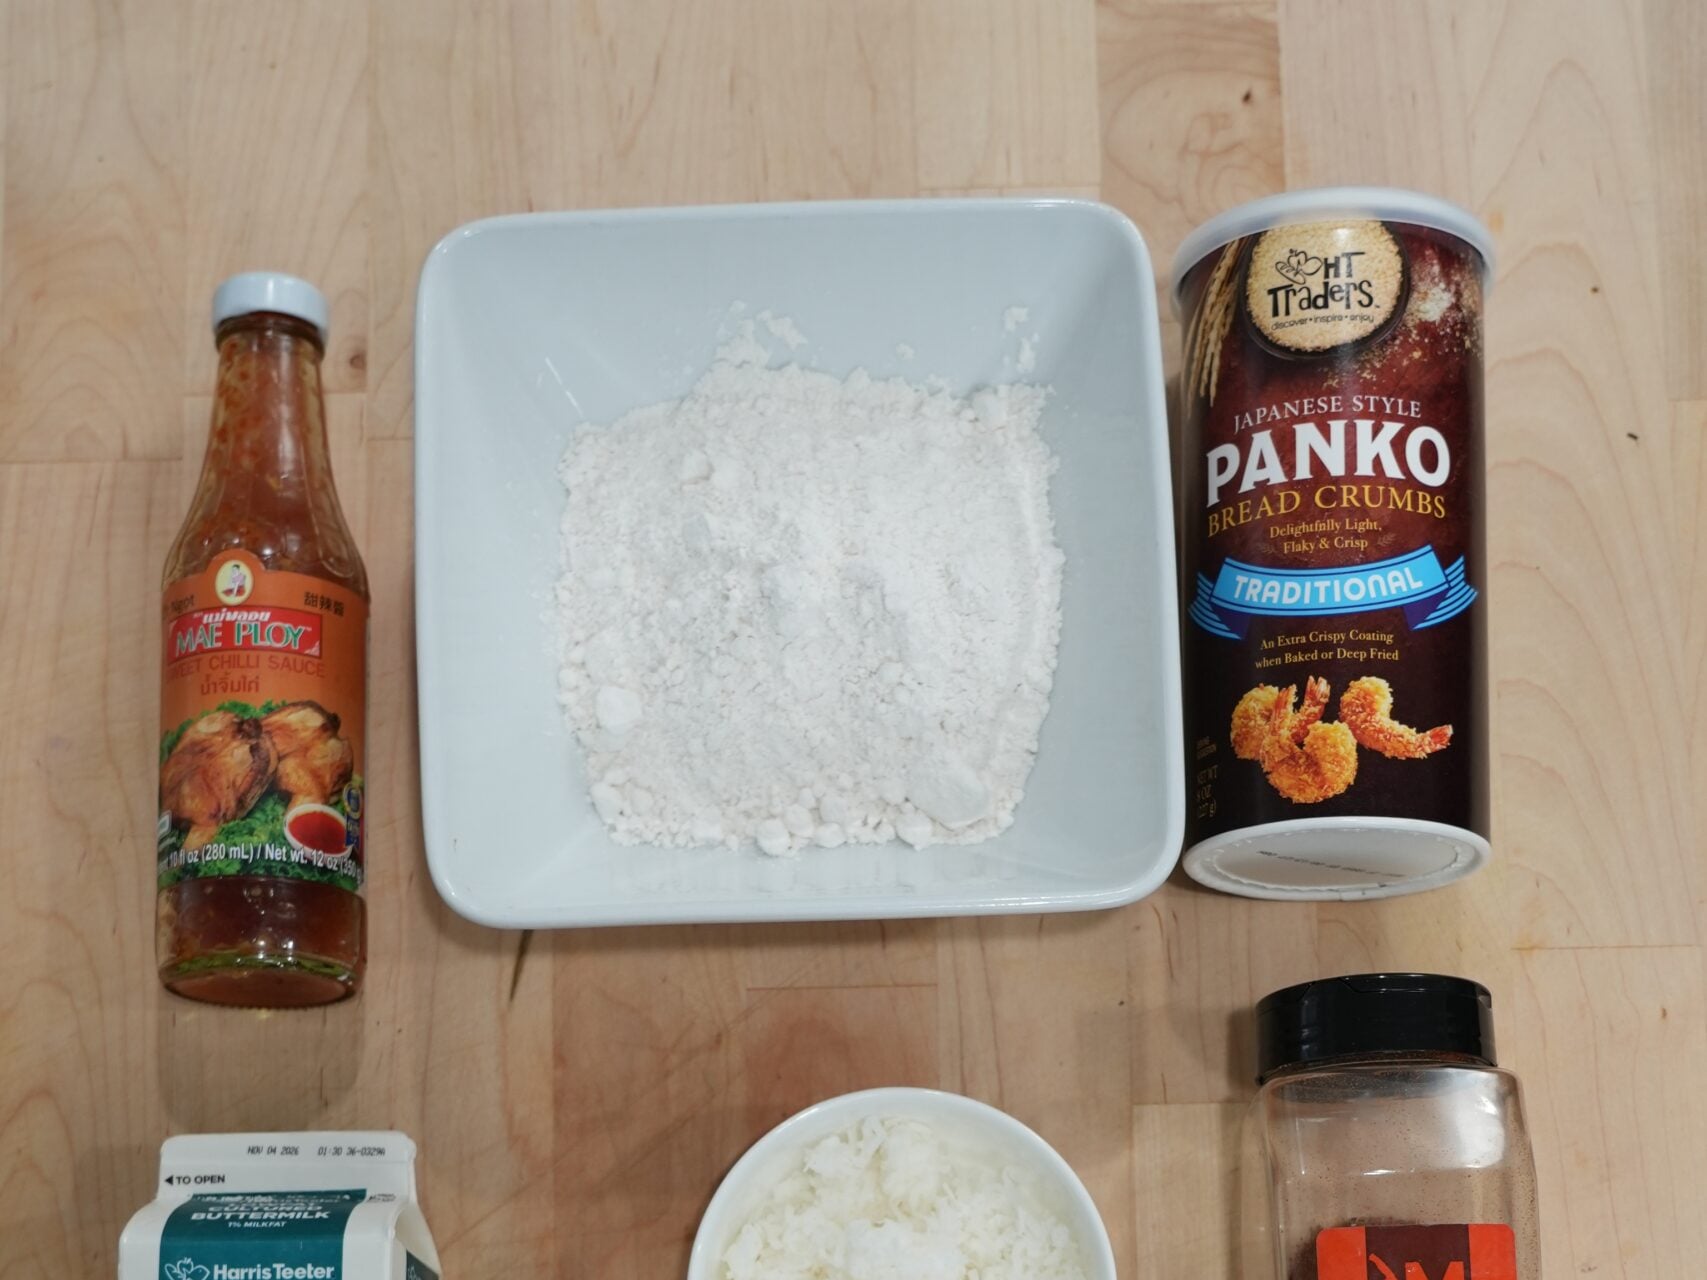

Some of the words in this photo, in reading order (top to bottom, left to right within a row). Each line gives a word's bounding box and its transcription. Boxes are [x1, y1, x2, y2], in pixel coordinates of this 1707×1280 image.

[1323, 252, 1365, 279] HT
[1267, 280, 1374, 318] Traders
[1271, 318, 1308, 331] discover
[1313, 315, 1343, 325] inspire
[1350, 314, 1374, 324] enjoy
[1234, 397, 1344, 434] JAPANESE
[1352, 396, 1421, 418] STYLE
[1206, 420, 1450, 508] PANKO
[1208, 490, 1300, 538] BREAD
[1314, 484, 1446, 519] CRUMBS
[1270, 523, 1340, 539] Delightfully
[1345, 519, 1382, 532] Light,
[1283, 541, 1315, 554] Flaky
[1319, 538, 1330, 550] &
[1334, 536, 1368, 551] Crisp
[1235, 566, 1424, 605] TRADITIONAL
[175, 622, 222, 656] MAE
[235, 621, 304, 650] PLOY
[1260, 639, 1274, 650] An
[1277, 634, 1306, 647] Extra
[1309, 630, 1346, 645] Crispy
[1350, 630, 1394, 645] Coating
[209, 653, 259, 670] CHILLI
[268, 655, 326, 678] SAUCE
[1255, 656, 1282, 670] when
[1284, 652, 1318, 665] Baked
[1320, 651, 1333, 661] or
[1337, 648, 1367, 663] Deep
[1370, 648, 1399, 661] Fried
[187, 849, 199, 863] oz
[202, 843, 226, 864] (280
[229, 842, 254, 864] mL)
[265, 844, 287, 861] Net
[312, 850, 325, 866] 12
[327, 857, 339, 871] oz
[176, 1175, 191, 1185] TO
[194, 1174, 225, 1185] OPEN
[191, 1211, 330, 1221] BUTTERMILK
[243, 1220, 287, 1228] MILKFAT
[213, 1264, 271, 1280] Harris
[272, 1264, 334, 1279] Teeter
